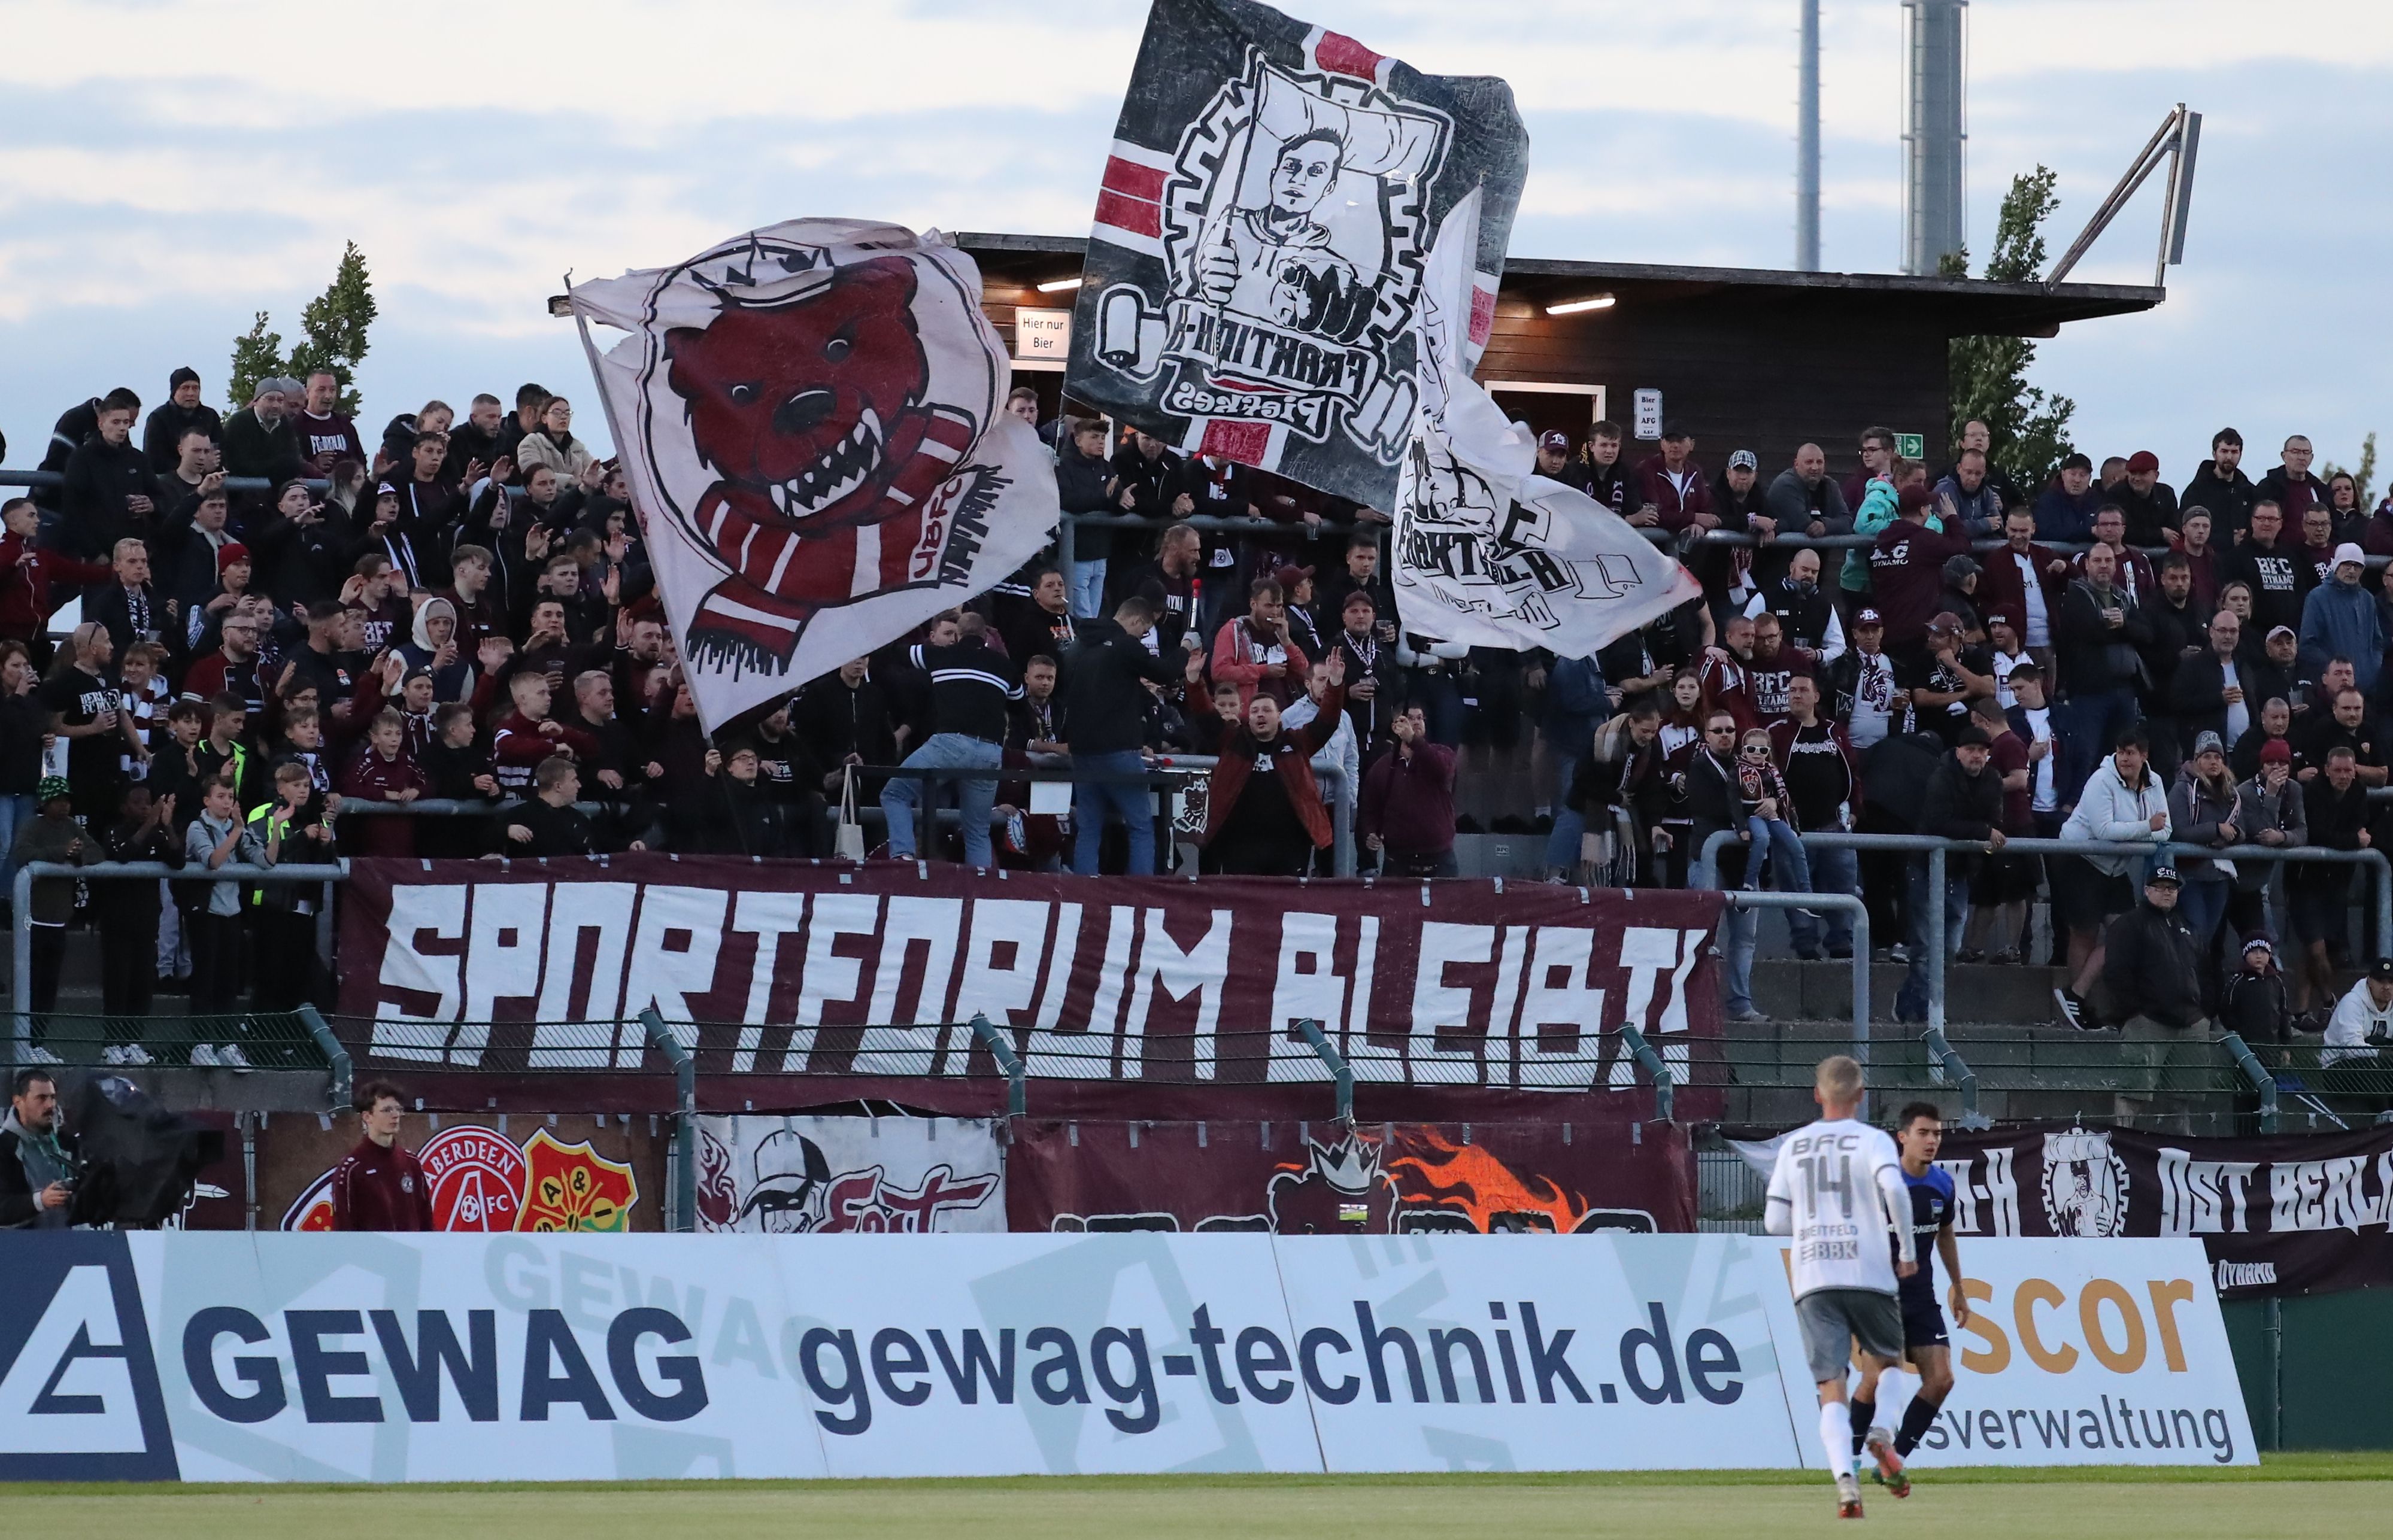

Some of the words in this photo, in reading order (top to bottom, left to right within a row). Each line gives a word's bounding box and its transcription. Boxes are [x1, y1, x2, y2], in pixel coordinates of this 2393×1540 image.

[1023, 317, 1044, 329] Hier
[1047, 321, 1064, 330] nur
[1034, 337, 1053, 348] Bier
[2254, 557, 2292, 575] BFC
[1751, 670, 1791, 694] BFC
[369, 882, 1232, 1081] SPORTFORUM
[1792, 1134, 1860, 1155] BFC
[423, 1139, 517, 1190] ABERDEEN
[1797, 1155, 1852, 1219] 14
[2268, 1152, 2393, 1235] BERLI
[486, 1193, 509, 1214] FC
[2218, 1259, 2277, 1290] DYNAMO
[183, 1307, 709, 1423] GEWAG
[799, 1301, 1744, 1436] gewag-technik.de
[1910, 1395, 2234, 1463] sverwaltung
